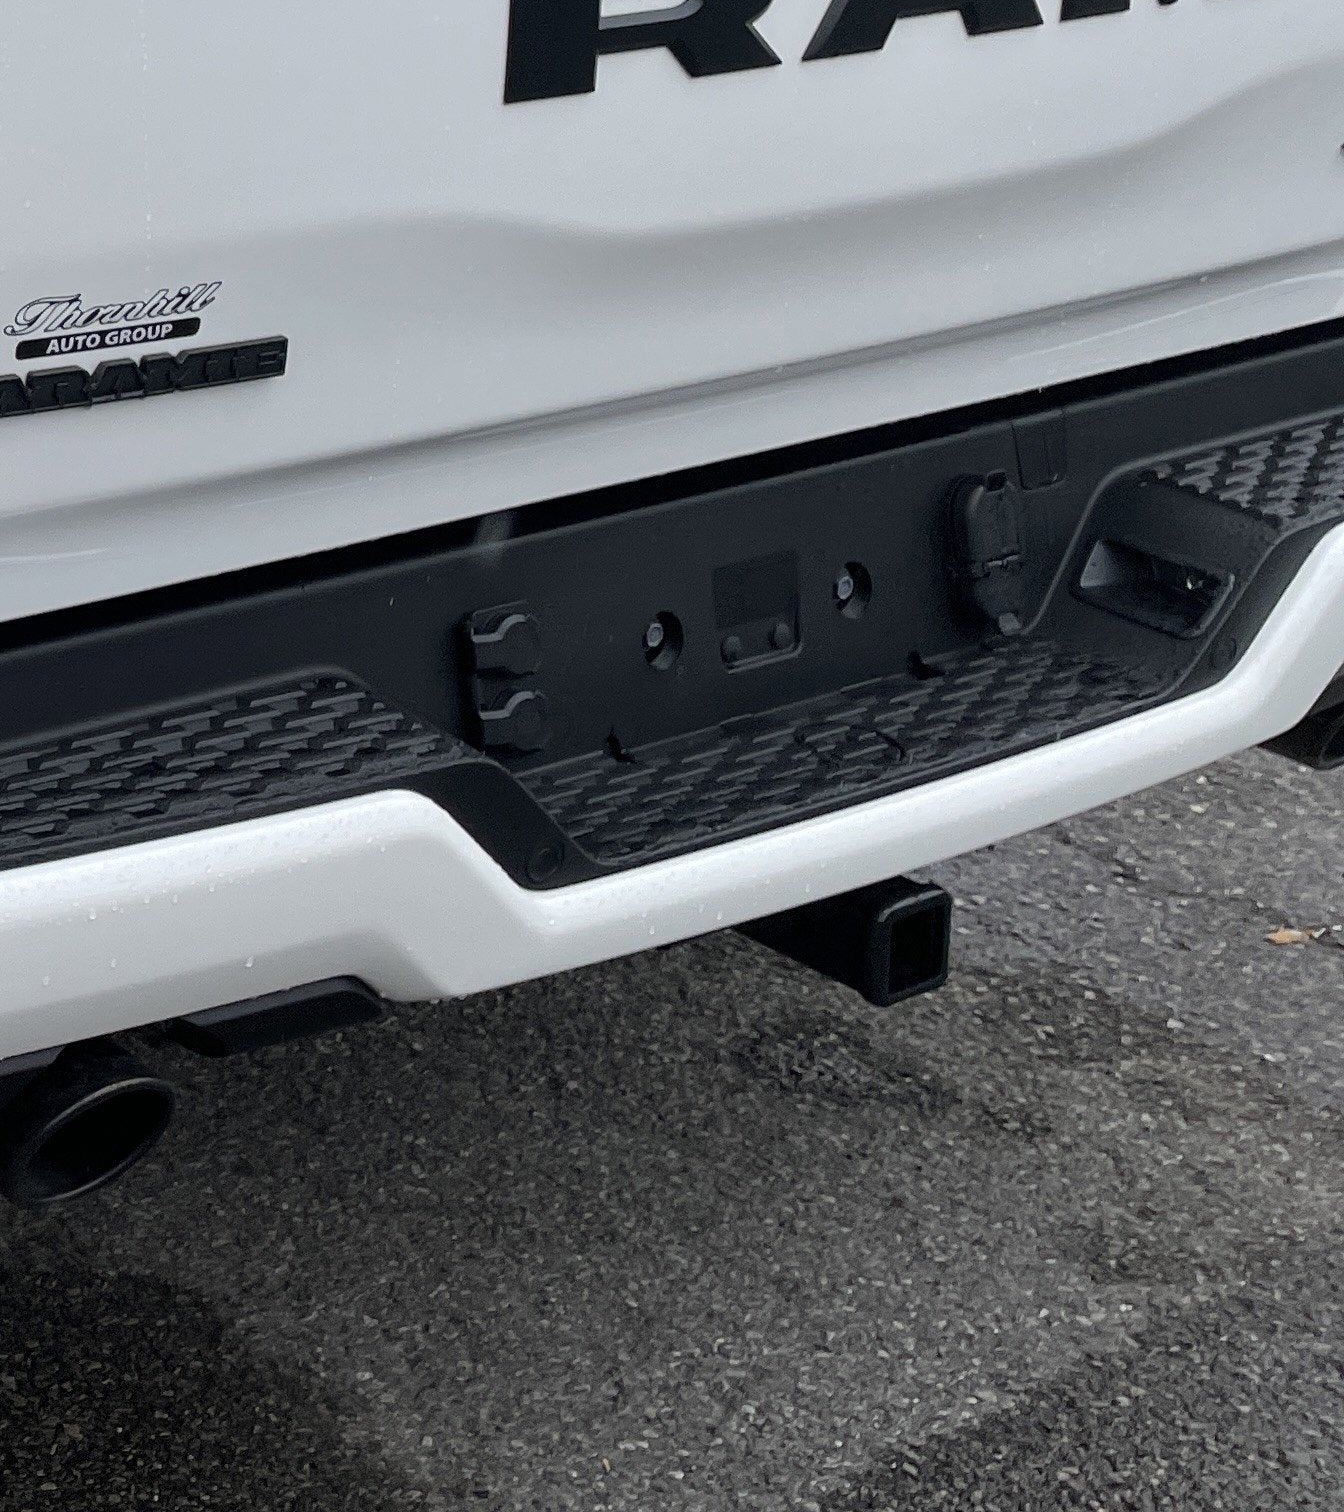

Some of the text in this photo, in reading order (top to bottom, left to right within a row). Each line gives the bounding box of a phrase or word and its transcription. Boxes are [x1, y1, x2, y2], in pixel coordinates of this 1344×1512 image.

[3, 280, 223, 337] Thornhill
[45, 322, 174, 355] AUTO GROUP
